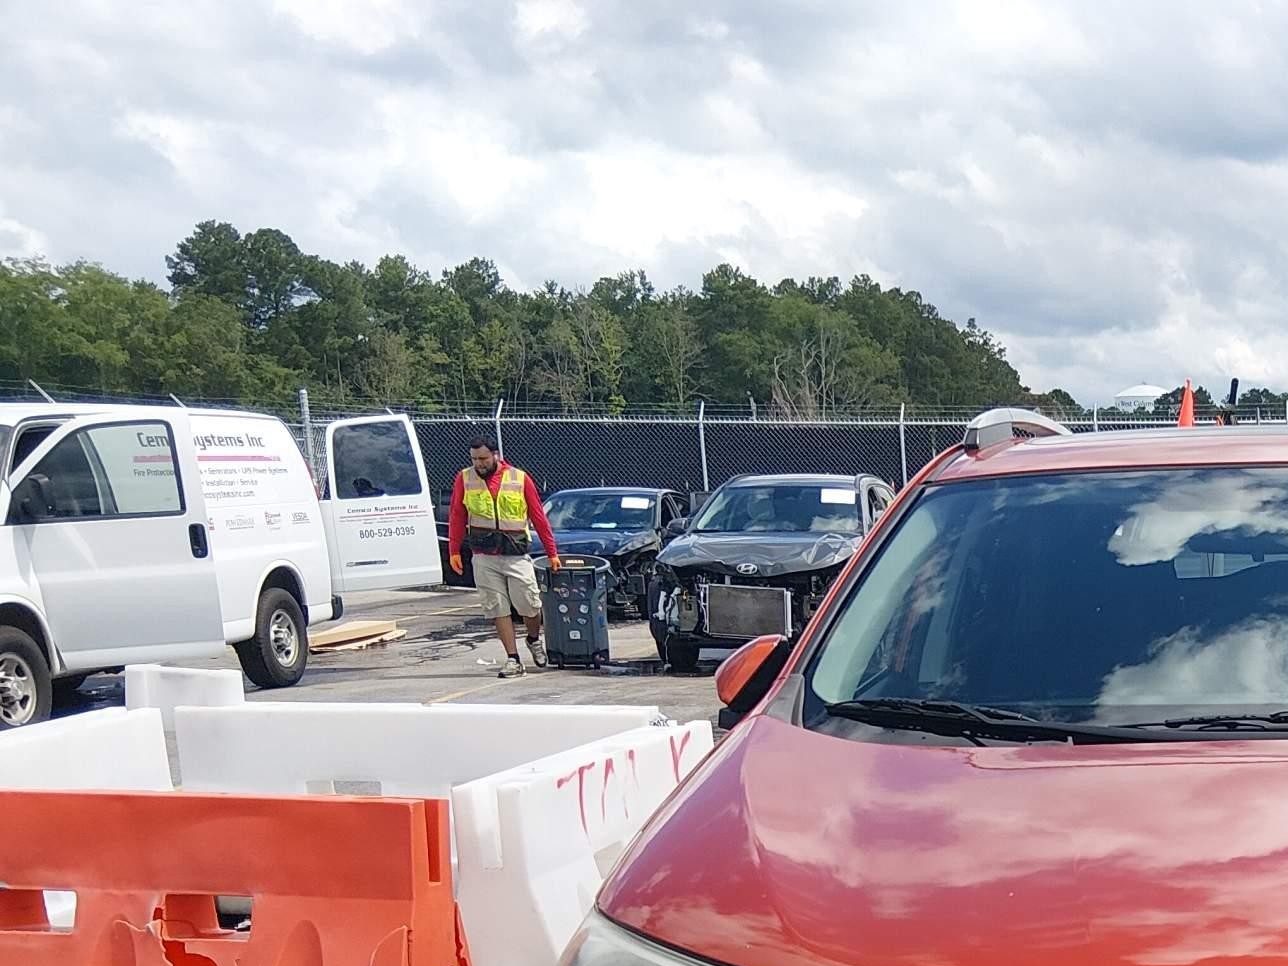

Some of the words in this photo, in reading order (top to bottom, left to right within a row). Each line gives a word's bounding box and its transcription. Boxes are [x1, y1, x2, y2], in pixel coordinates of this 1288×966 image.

[245, 433, 265, 448] Inc
[146, 468, 175, 477] Protectio
[359, 526, 416, 539] 800-529-0395
